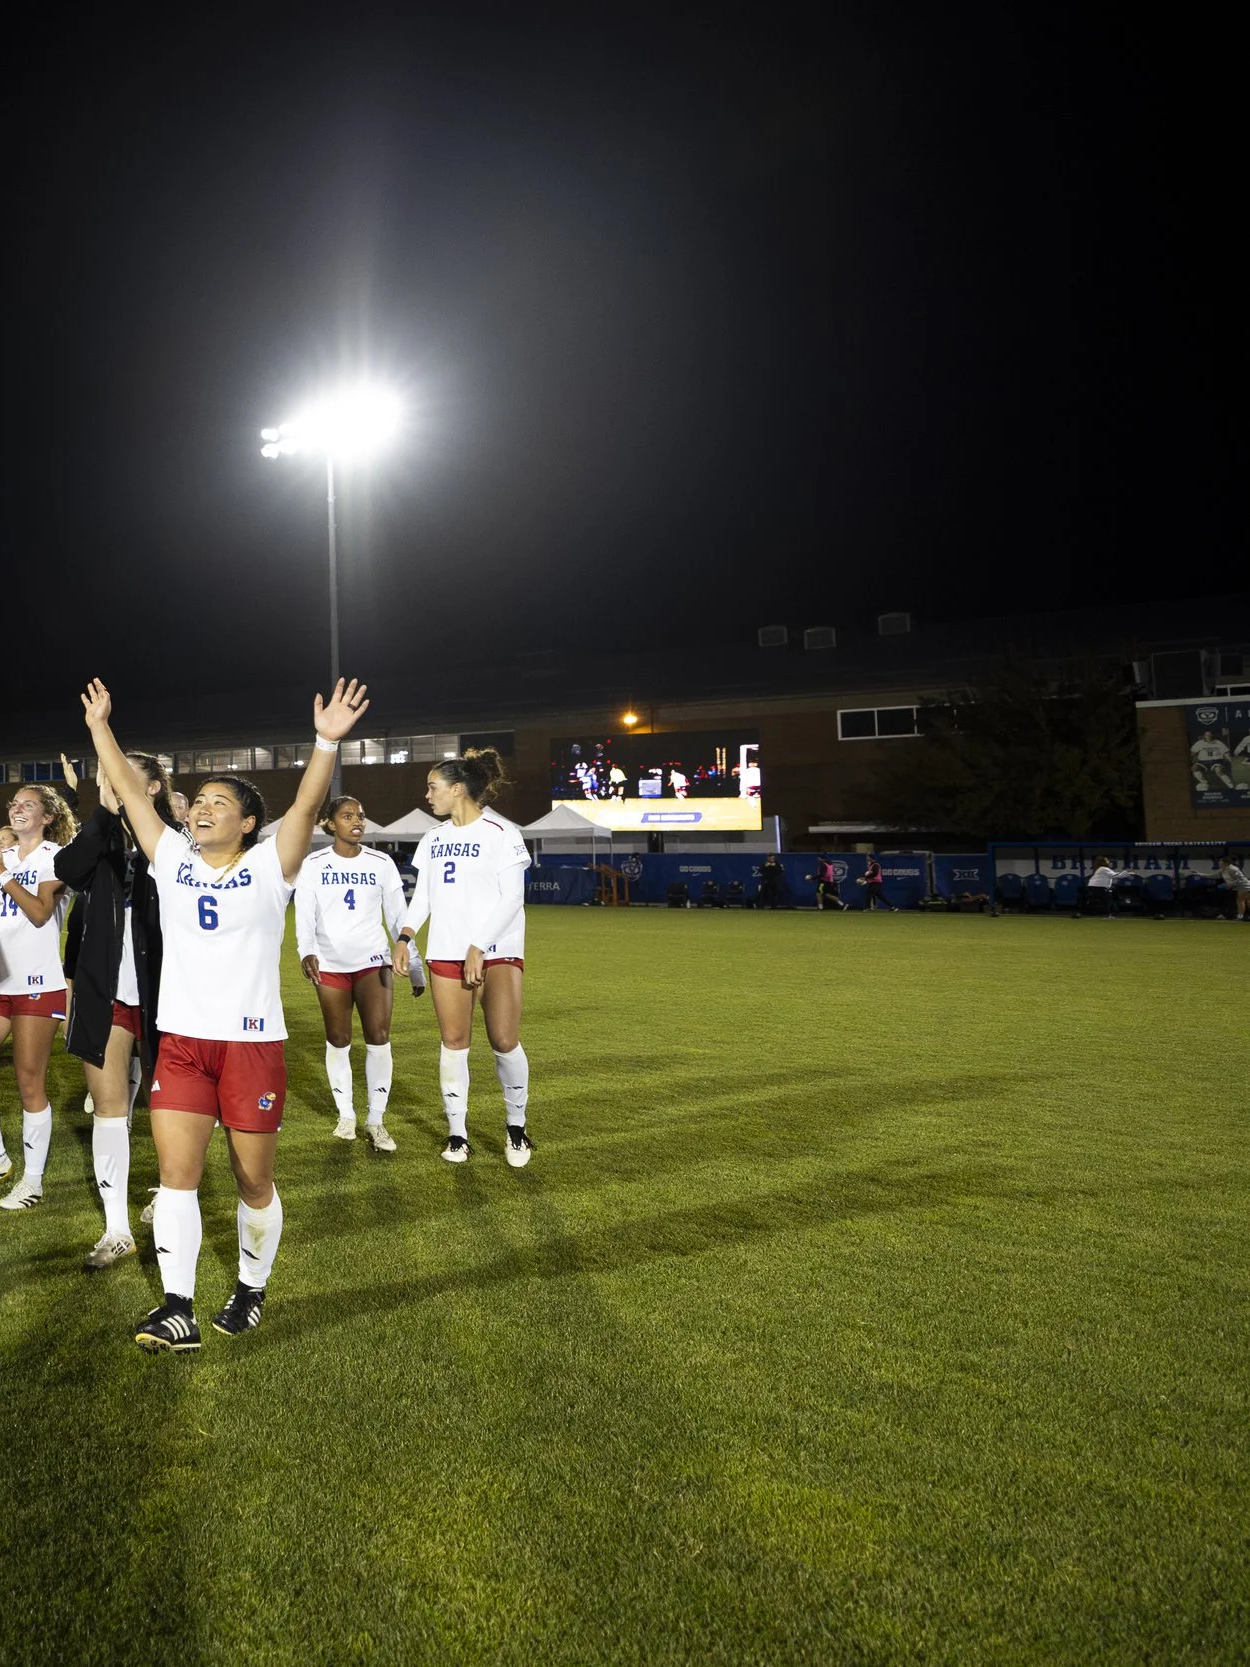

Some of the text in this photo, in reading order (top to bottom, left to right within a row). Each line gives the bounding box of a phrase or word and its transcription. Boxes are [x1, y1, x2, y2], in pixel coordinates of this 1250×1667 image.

[430, 843, 481, 859] KANSAS
[321, 872, 377, 885] KANSAS
[443, 861, 456, 884] 2
[343, 889, 356, 911] 4
[197, 895, 219, 931] 6
